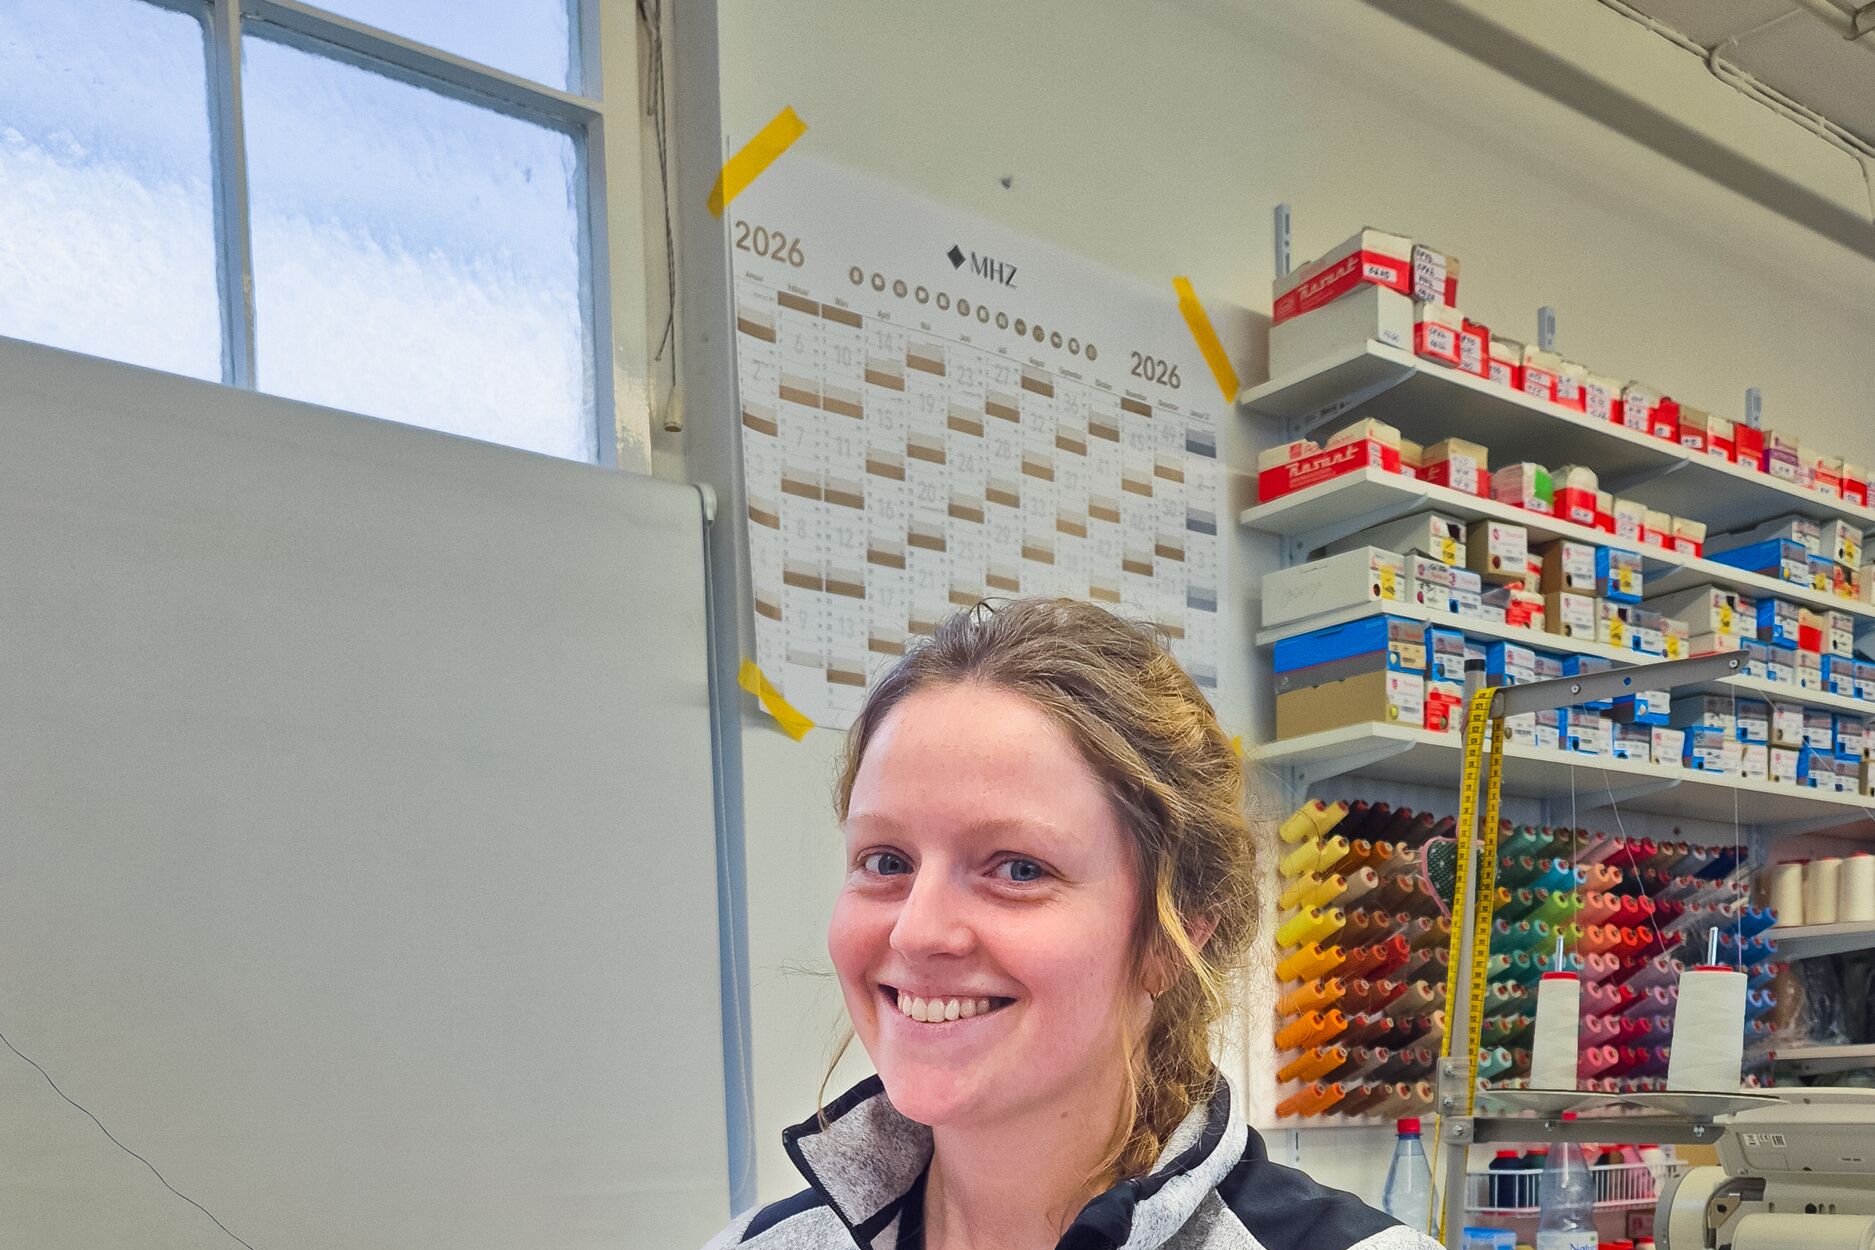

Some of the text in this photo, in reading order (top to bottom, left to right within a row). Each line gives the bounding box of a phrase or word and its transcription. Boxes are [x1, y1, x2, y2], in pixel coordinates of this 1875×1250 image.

[735, 220, 805, 268] 2026
[970, 251, 1018, 289] MHZ
[1130, 350, 1182, 389] 2026
